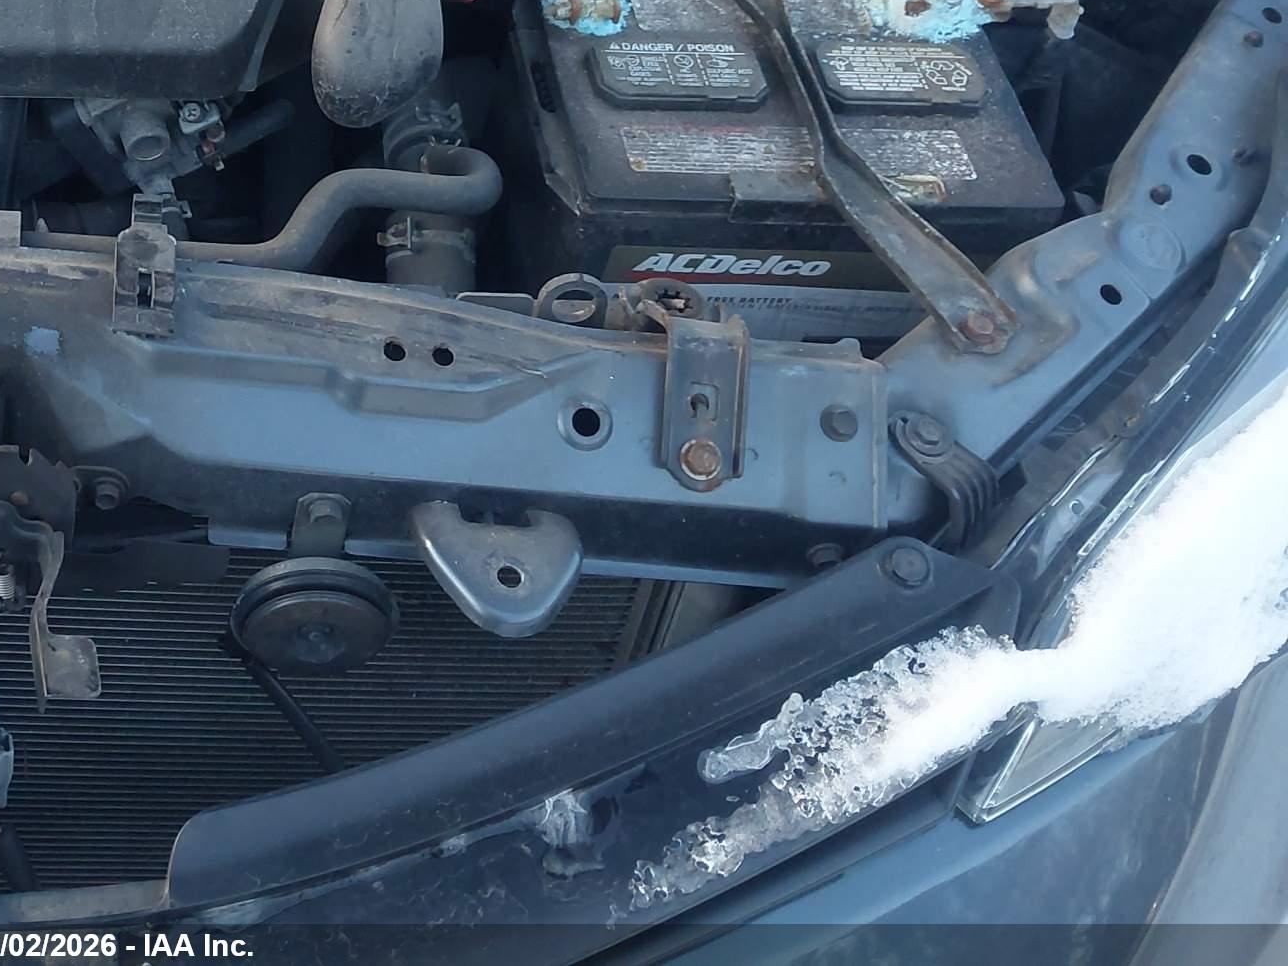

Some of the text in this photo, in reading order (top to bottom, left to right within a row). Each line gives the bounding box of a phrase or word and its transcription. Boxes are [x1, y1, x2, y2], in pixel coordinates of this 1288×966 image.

[622, 42, 674, 52] DANGER
[687, 44, 735, 53] POISON
[632, 252, 832, 277] ACDelco
[706, 296, 792, 305] FREE BATTERY
